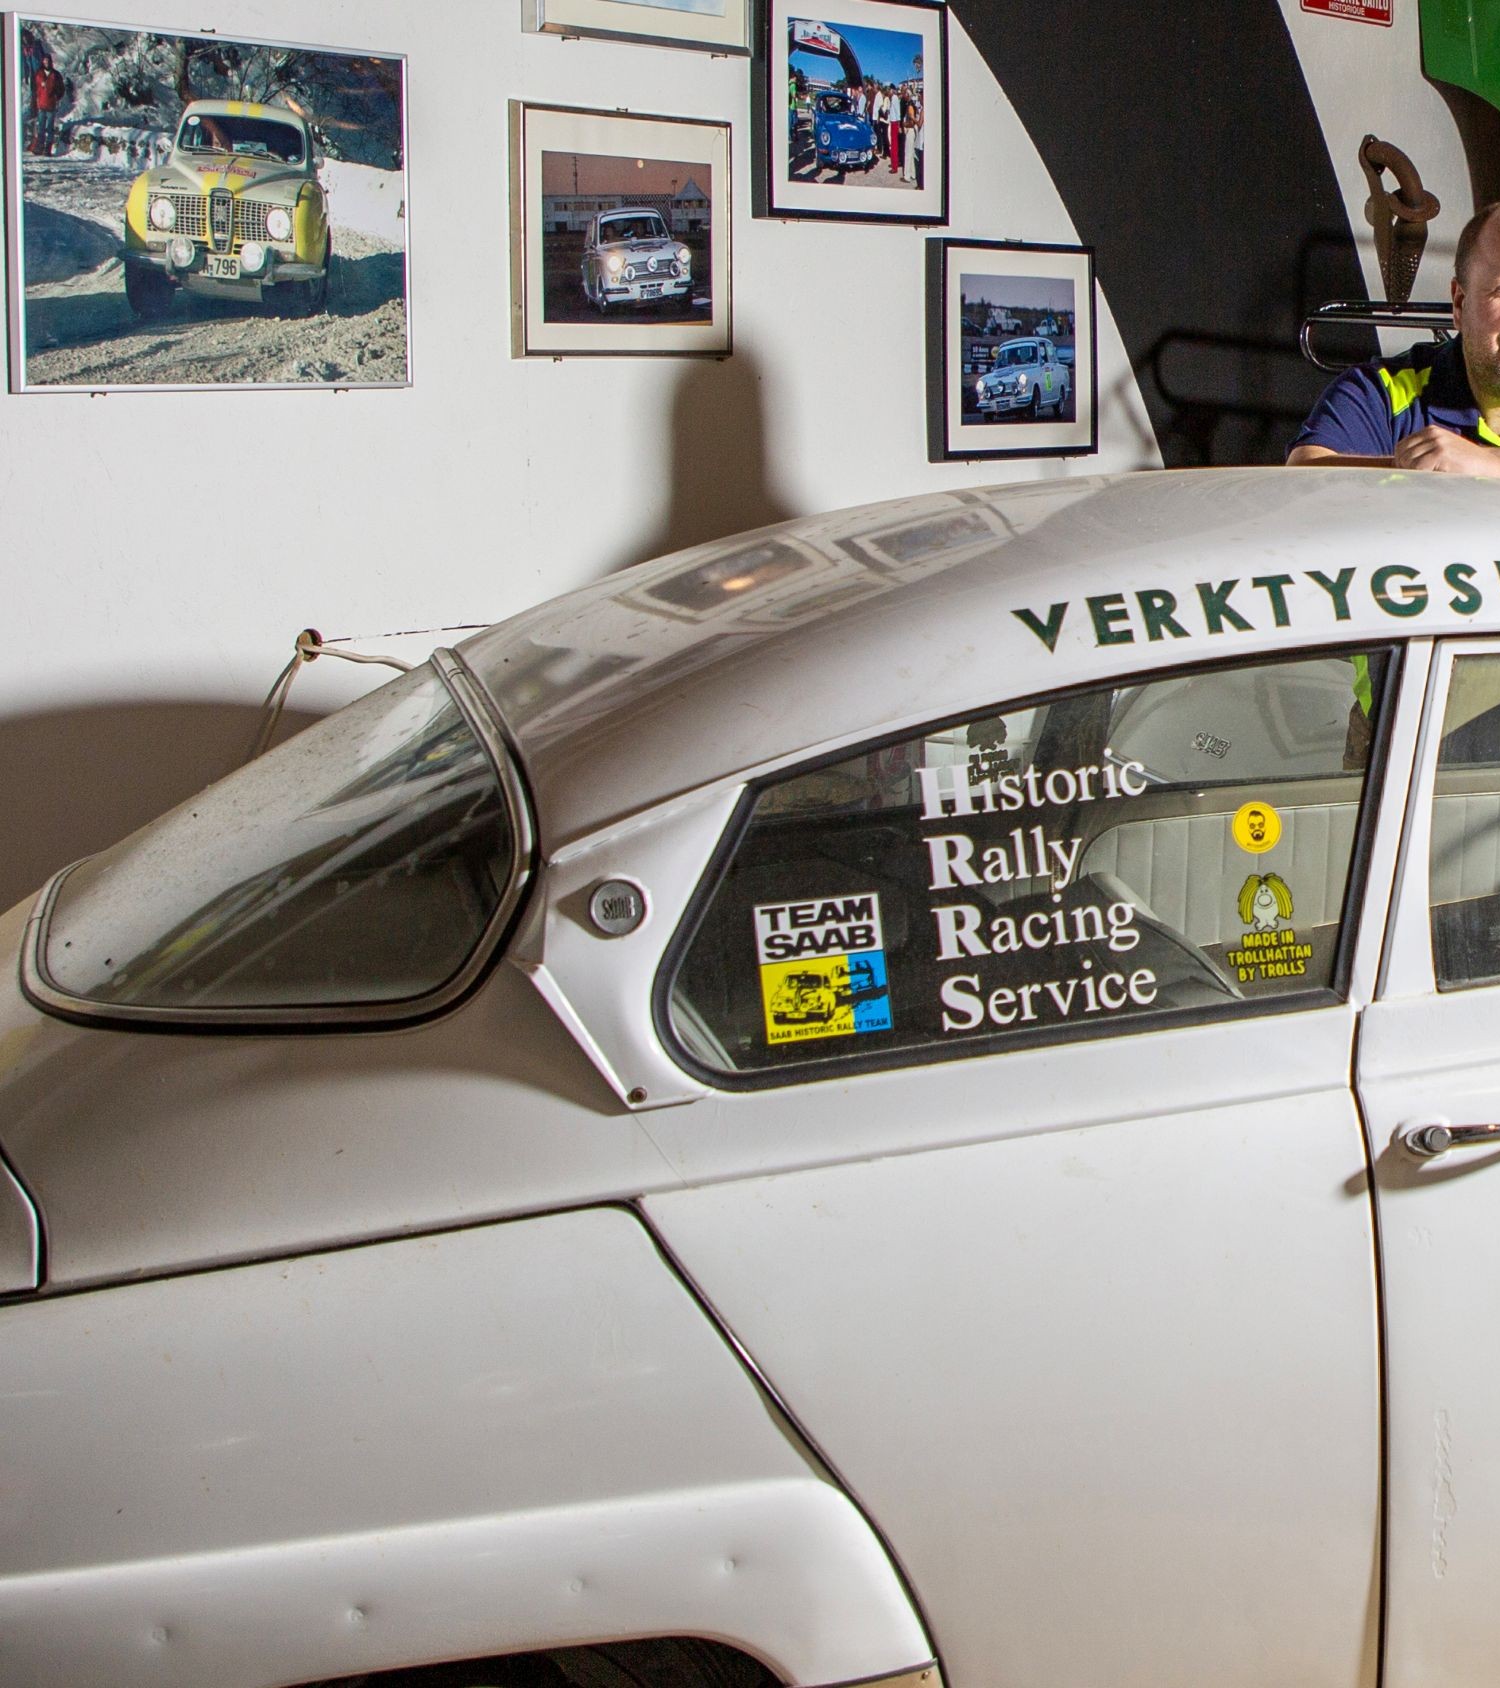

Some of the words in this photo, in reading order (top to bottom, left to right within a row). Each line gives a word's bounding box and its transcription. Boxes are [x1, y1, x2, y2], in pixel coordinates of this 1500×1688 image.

[1328, 1, 1365, 16] HISTORIQUE
[915, 748, 1148, 820] Historic
[922, 825, 1082, 890] Rally
[760, 897, 873, 932] TEAM
[930, 893, 1140, 961] Racing
[764, 924, 876, 960] SAAB
[1227, 944, 1313, 967] TROLLHATTAN
[1242, 931, 1278, 949] MADE
[1281, 928, 1295, 945] IN
[1238, 967, 1256, 983] BY
[1260, 960, 1306, 980] TROLLS
[940, 960, 1158, 1032] Service
[770, 1031, 792, 1040] SAAB
[795, 1025, 834, 1036] HISTORIC
[837, 1021, 863, 1031] RALLY
[866, 1017, 888, 1028] TEAM
